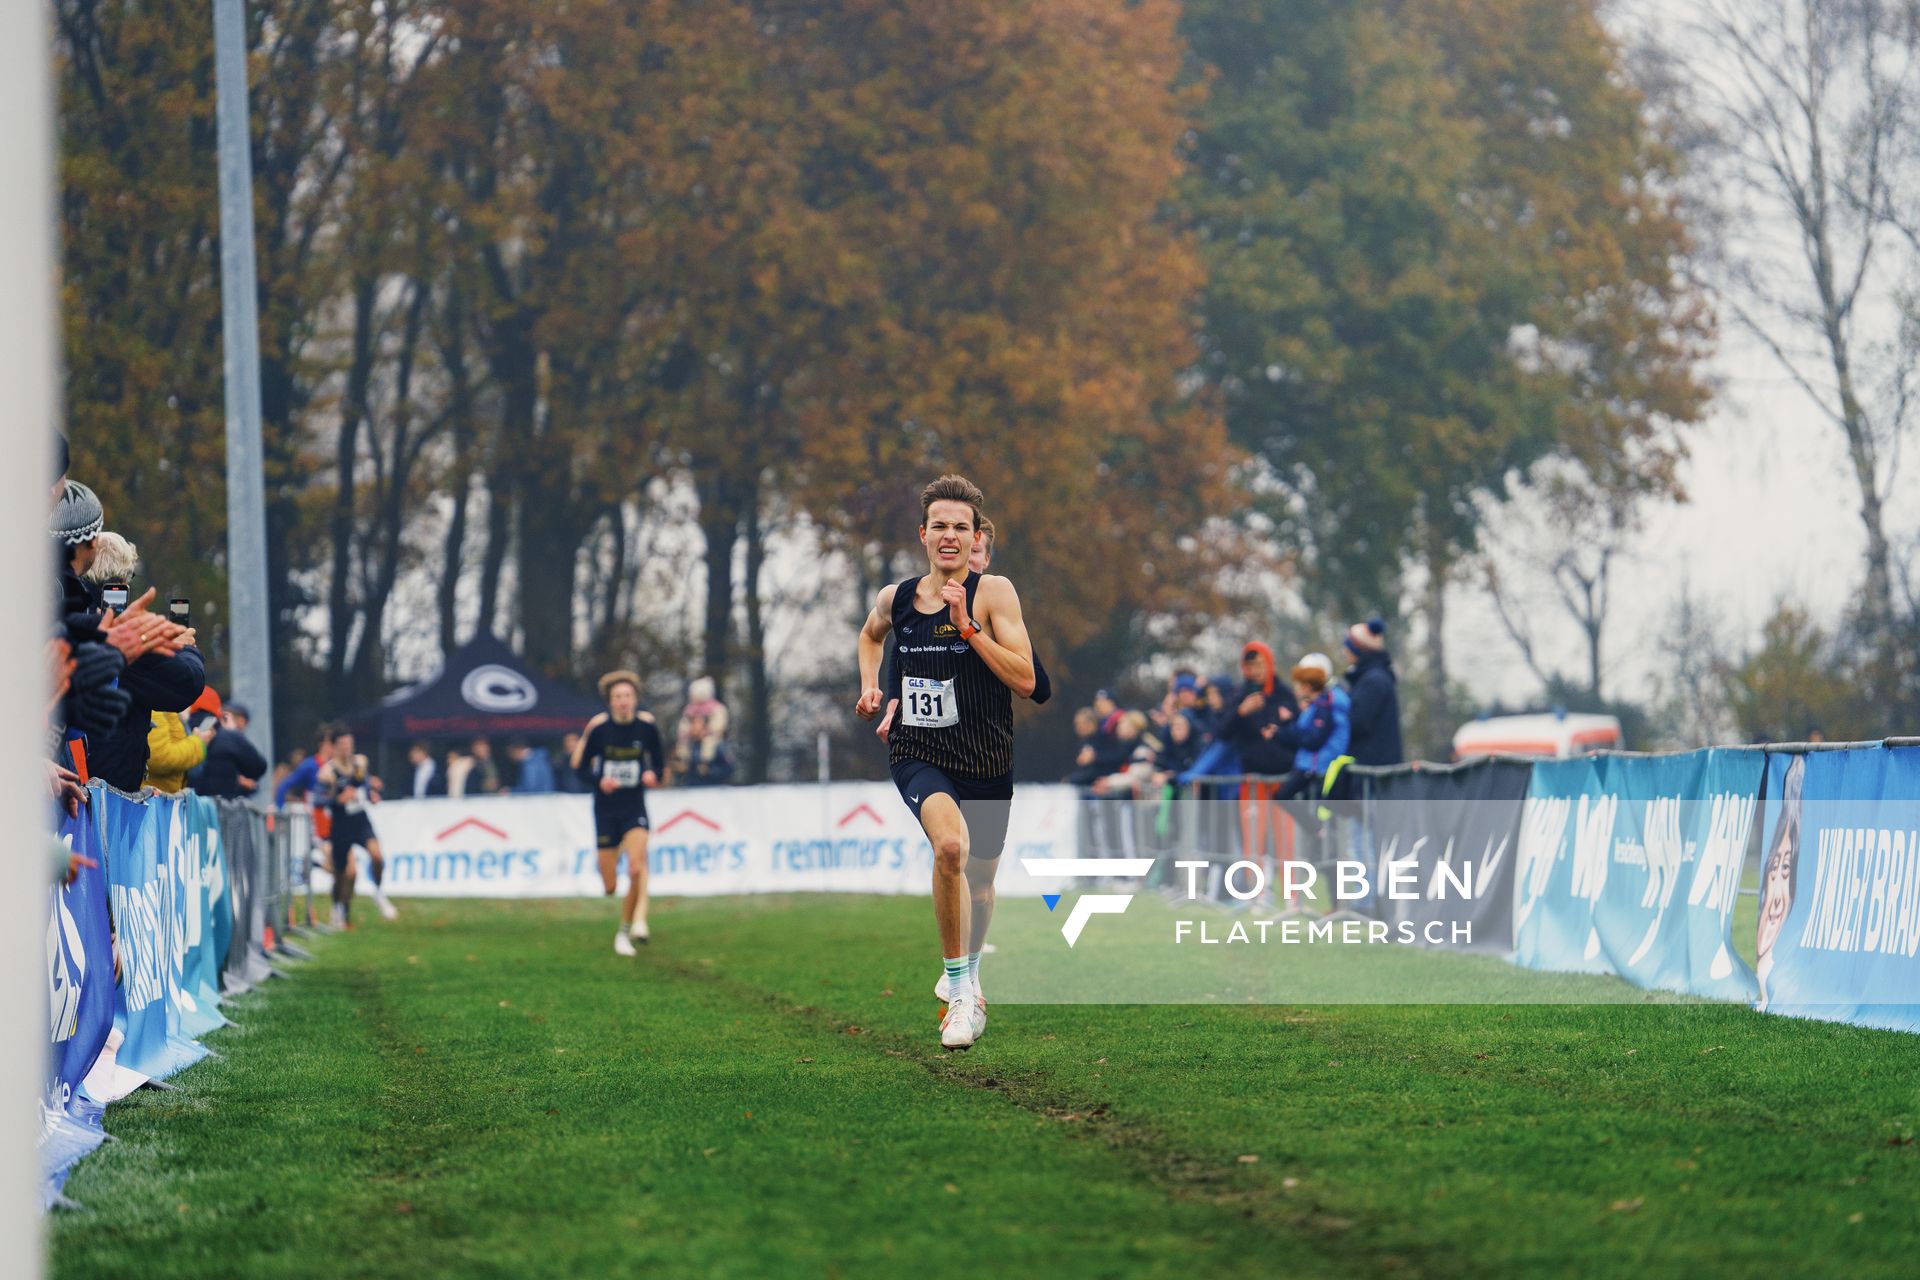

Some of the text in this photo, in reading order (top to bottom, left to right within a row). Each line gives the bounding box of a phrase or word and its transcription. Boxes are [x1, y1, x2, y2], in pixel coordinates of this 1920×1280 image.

[909, 692, 943, 717] 131
[367, 849, 541, 881] mmers
[573, 840, 747, 876] rmers
